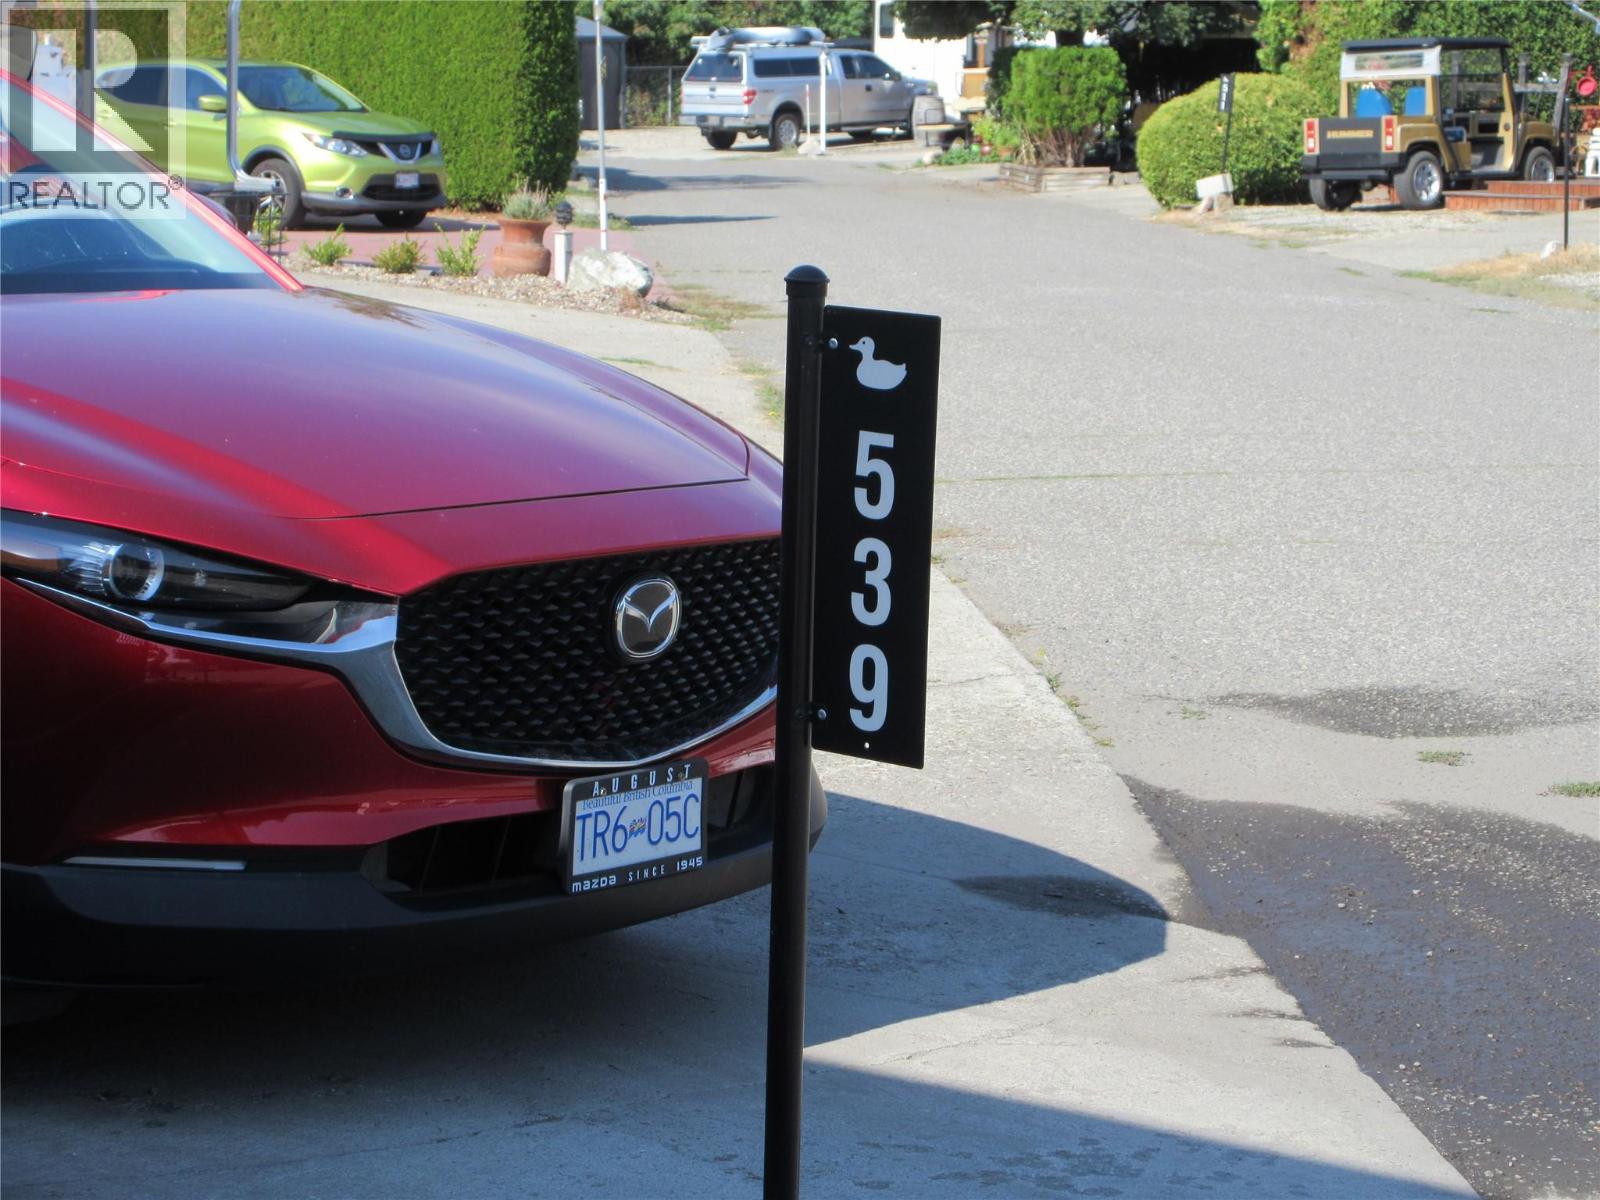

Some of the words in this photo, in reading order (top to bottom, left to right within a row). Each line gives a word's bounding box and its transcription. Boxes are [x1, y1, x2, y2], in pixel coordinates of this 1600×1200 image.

[848, 430, 896, 733] 539
[592, 763, 691, 797] AUGUST
[623, 788, 651, 803] British
[652, 781, 694, 797] Columbia
[576, 805, 628, 861] TR6
[628, 864, 665, 882] SINCE
[676, 856, 703, 871] 1945
